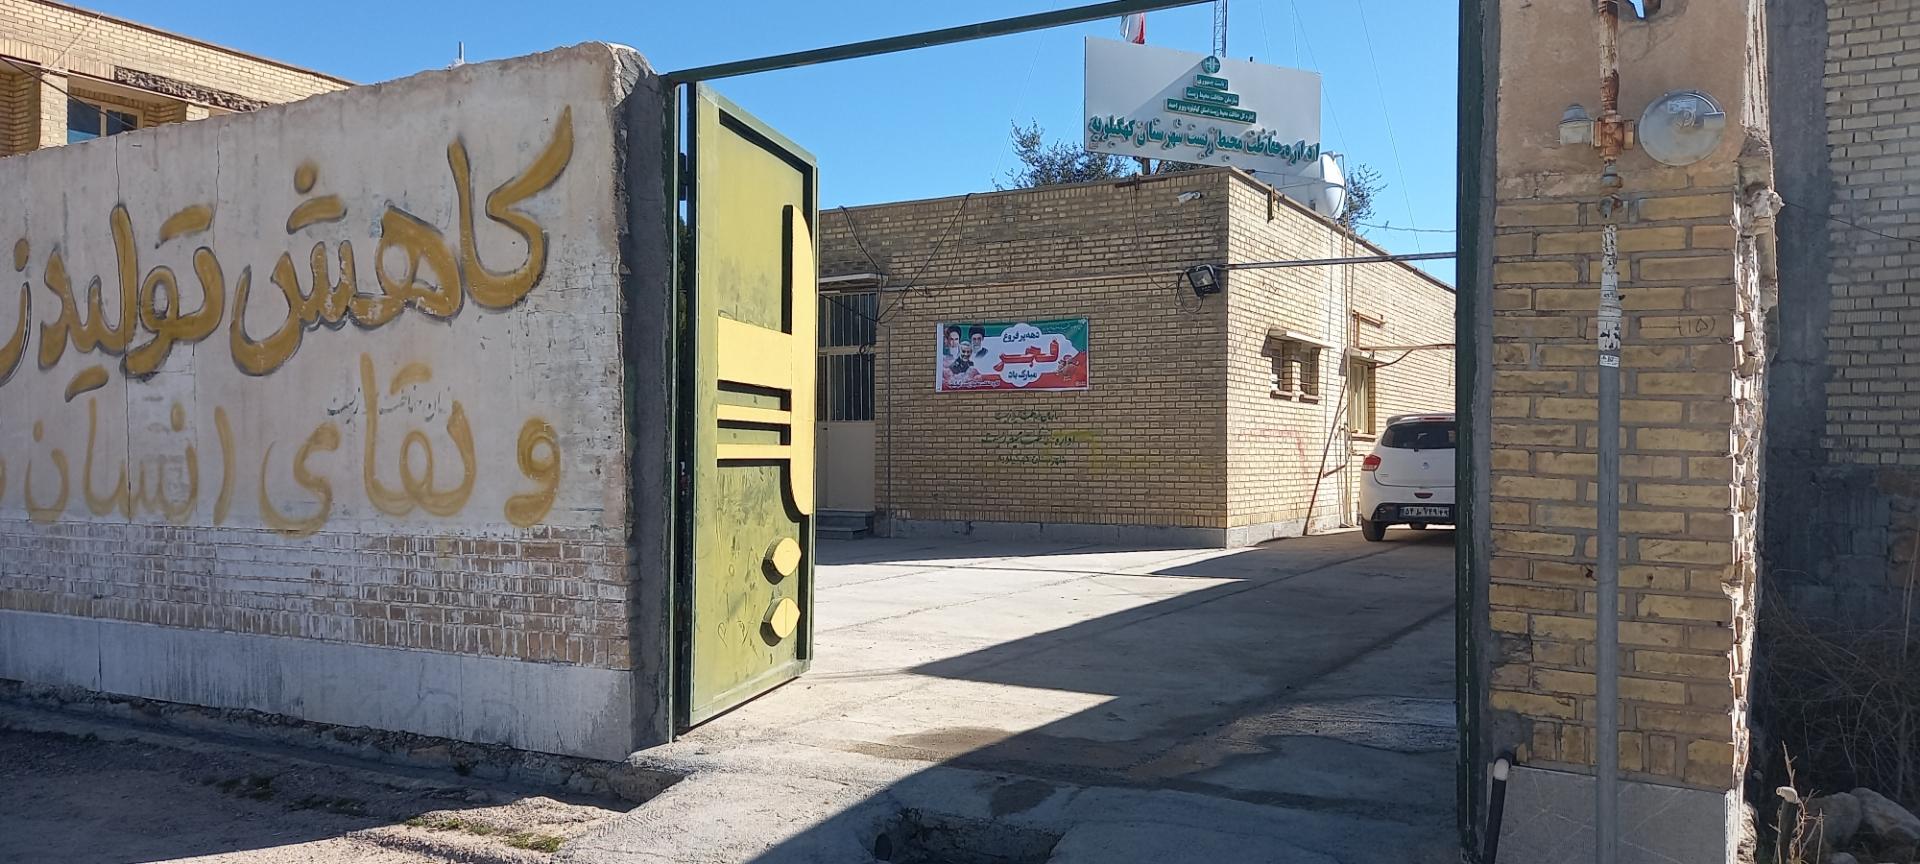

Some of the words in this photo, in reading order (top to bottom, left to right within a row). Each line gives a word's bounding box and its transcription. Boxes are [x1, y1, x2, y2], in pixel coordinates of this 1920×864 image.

[1088, 114, 1136, 146] کهگیلویه
[1135, 117, 1184, 149] شهرستان
[1186, 122, 1216, 159] زیست
[1216, 128, 1244, 160] محیط
[1246, 127, 1283, 155] حفاظت
[1282, 139, 1320, 165] اداره
[230, 104, 574, 377] کاهش
[38, 203, 225, 402] تولید
[1003, 331, 1019, 343] فروغ
[1026, 331, 1040, 339] دهه
[993, 339, 1059, 372] فجر
[1007, 370, 1018, 379] باد
[1018, 369, 1038, 381] مبارک
[24, 397, 236, 526] انسان
[504, 416, 561, 529] و
